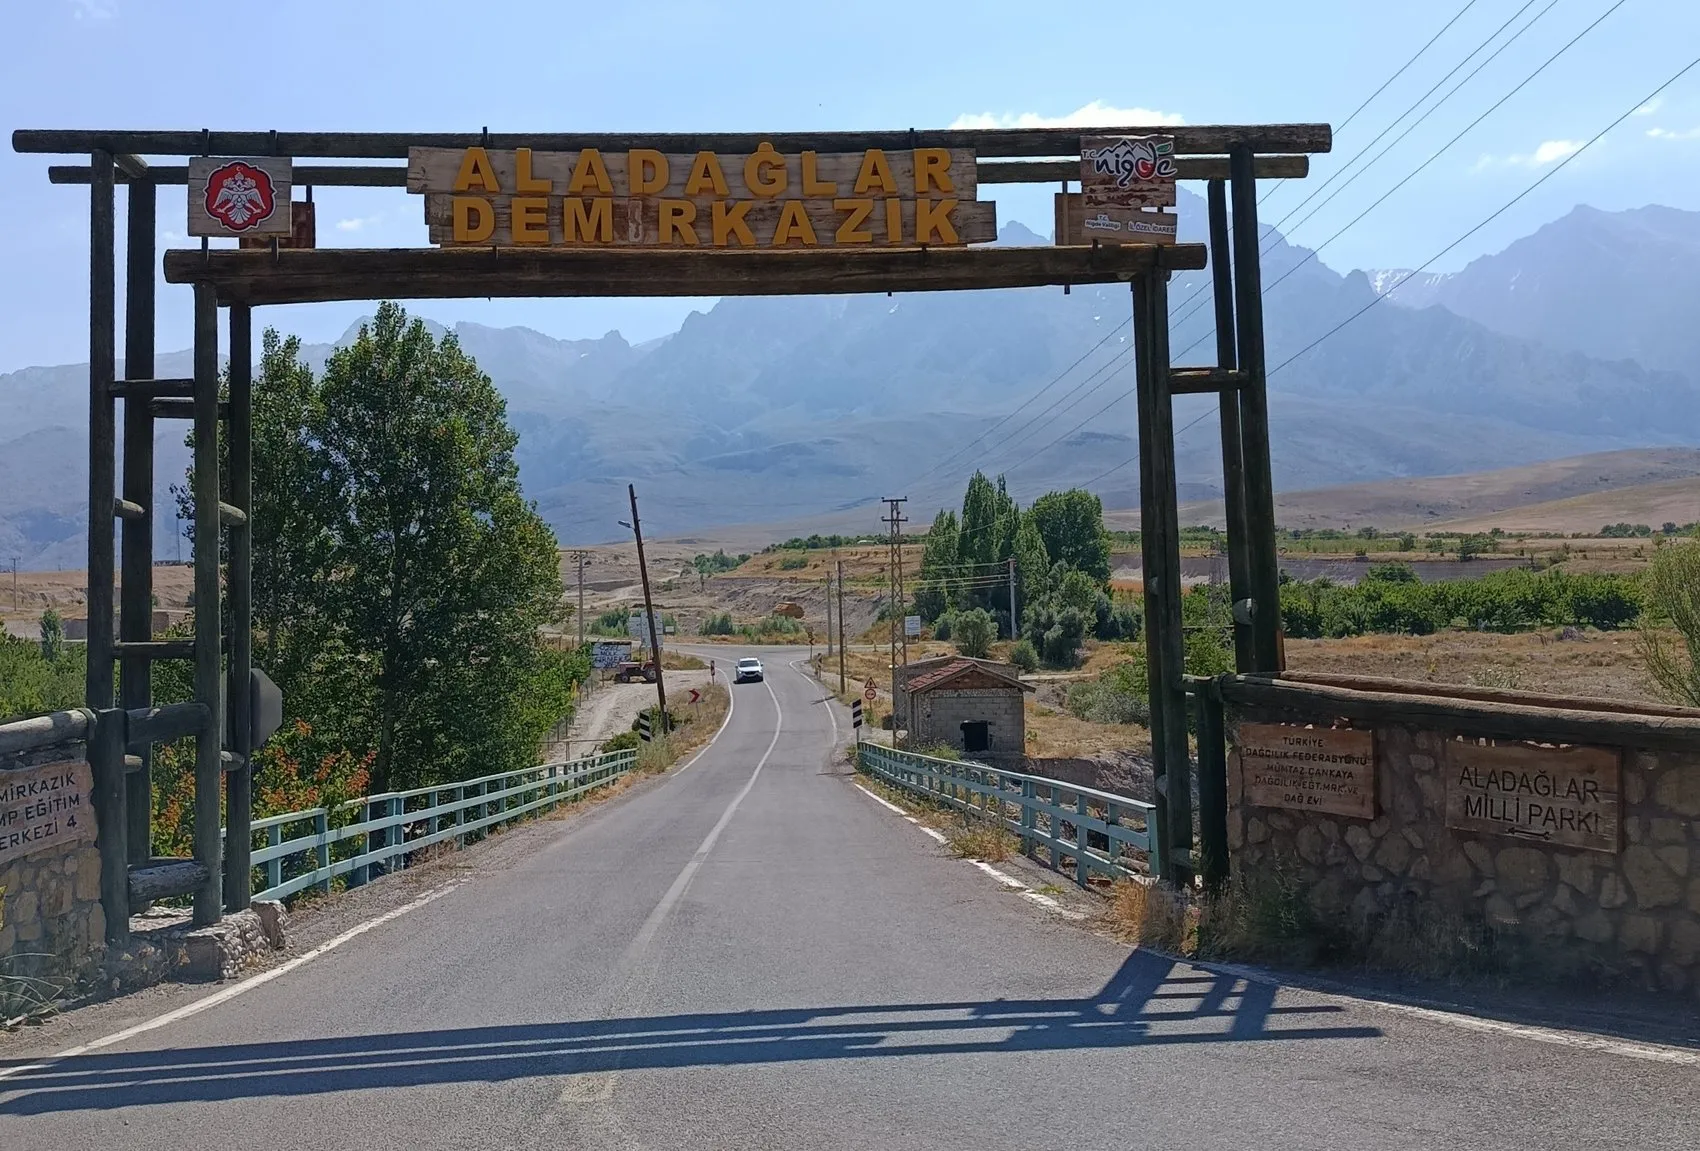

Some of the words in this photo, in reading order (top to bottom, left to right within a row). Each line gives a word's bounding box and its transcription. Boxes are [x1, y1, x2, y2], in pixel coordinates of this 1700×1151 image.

[453, 141, 954, 197] ALADAĞLAR
[1459, 765, 1600, 805] ALADAĞLAR
[1465, 793, 1520, 823] MİLLİ
[1528, 803, 1599, 834] PARKI
